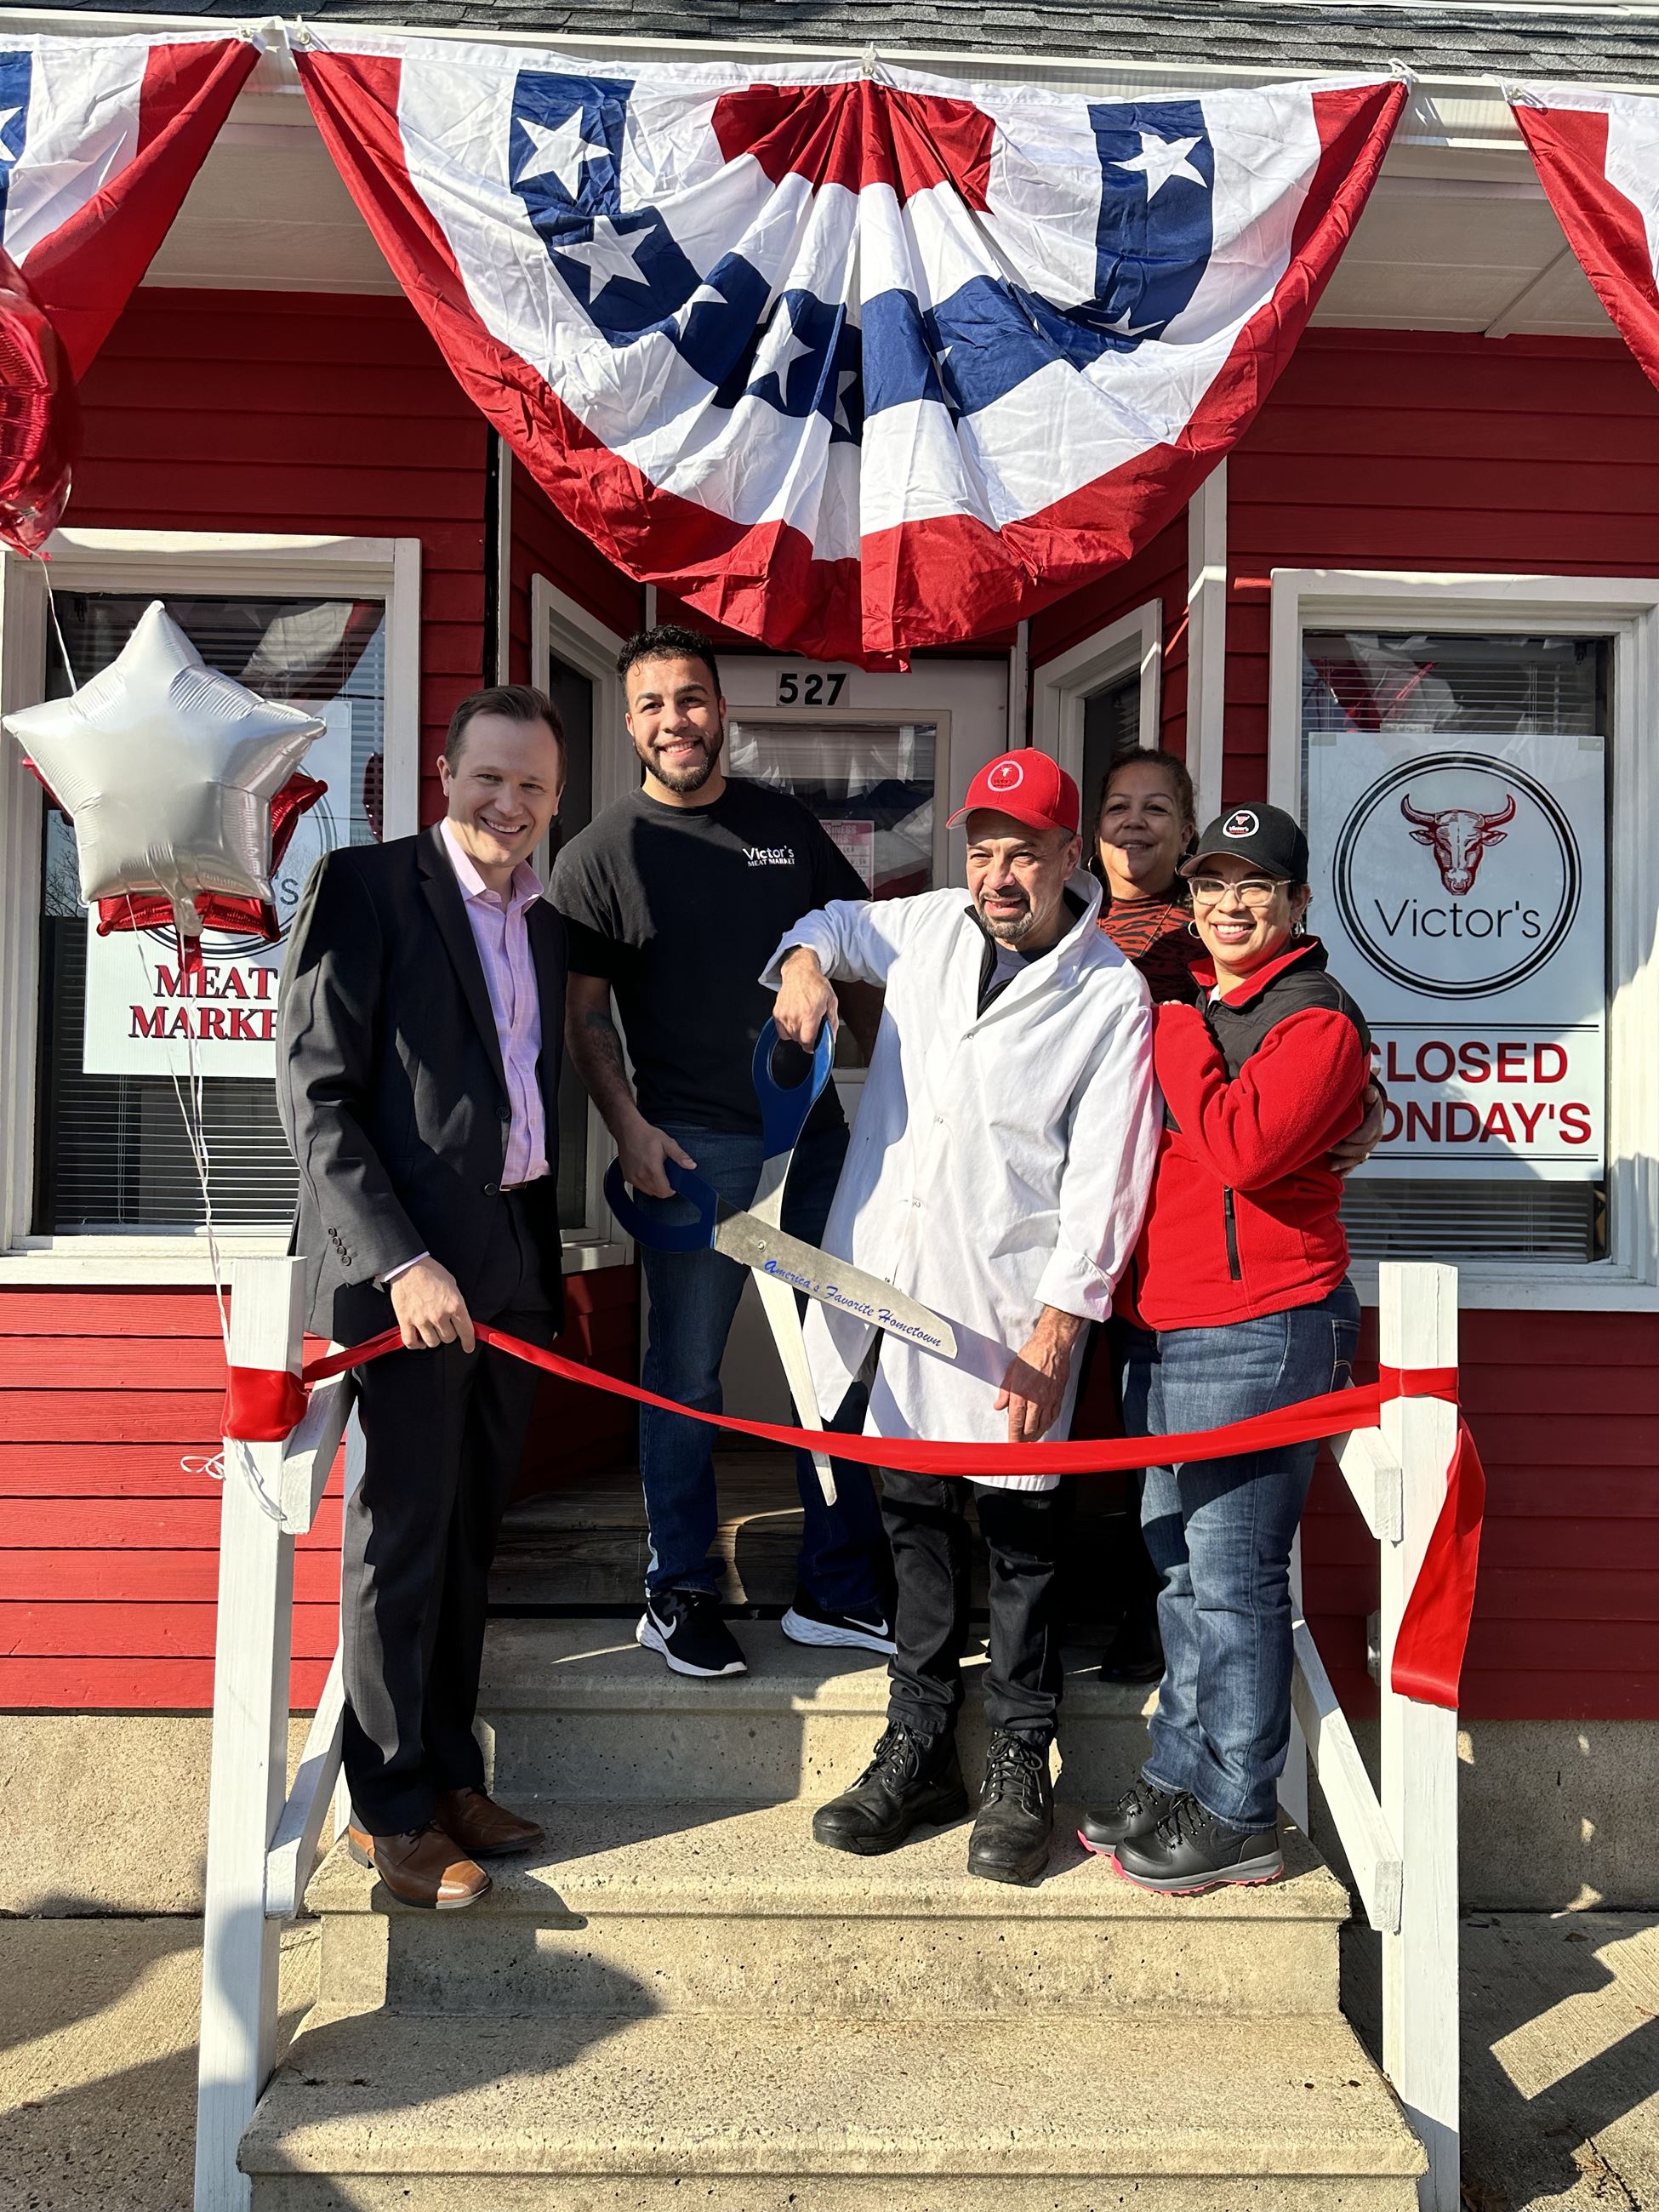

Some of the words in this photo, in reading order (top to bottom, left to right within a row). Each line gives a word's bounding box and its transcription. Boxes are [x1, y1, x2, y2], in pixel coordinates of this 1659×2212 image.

[778, 673, 847, 706] 527
[824, 824, 858, 835] SINESS
[742, 845, 795, 860] Victor's
[748, 858, 767, 867] MEAT
[1374, 898, 1541, 938] Victor's
[153, 965, 278, 1000] MEAT
[128, 1005, 278, 1040] MARKE
[1371, 1040, 1568, 1084] LOSED
[764, 1259, 819, 1293] America's
[824, 1286, 874, 1317] Favorite
[877, 1308, 942, 1347] Hometown
